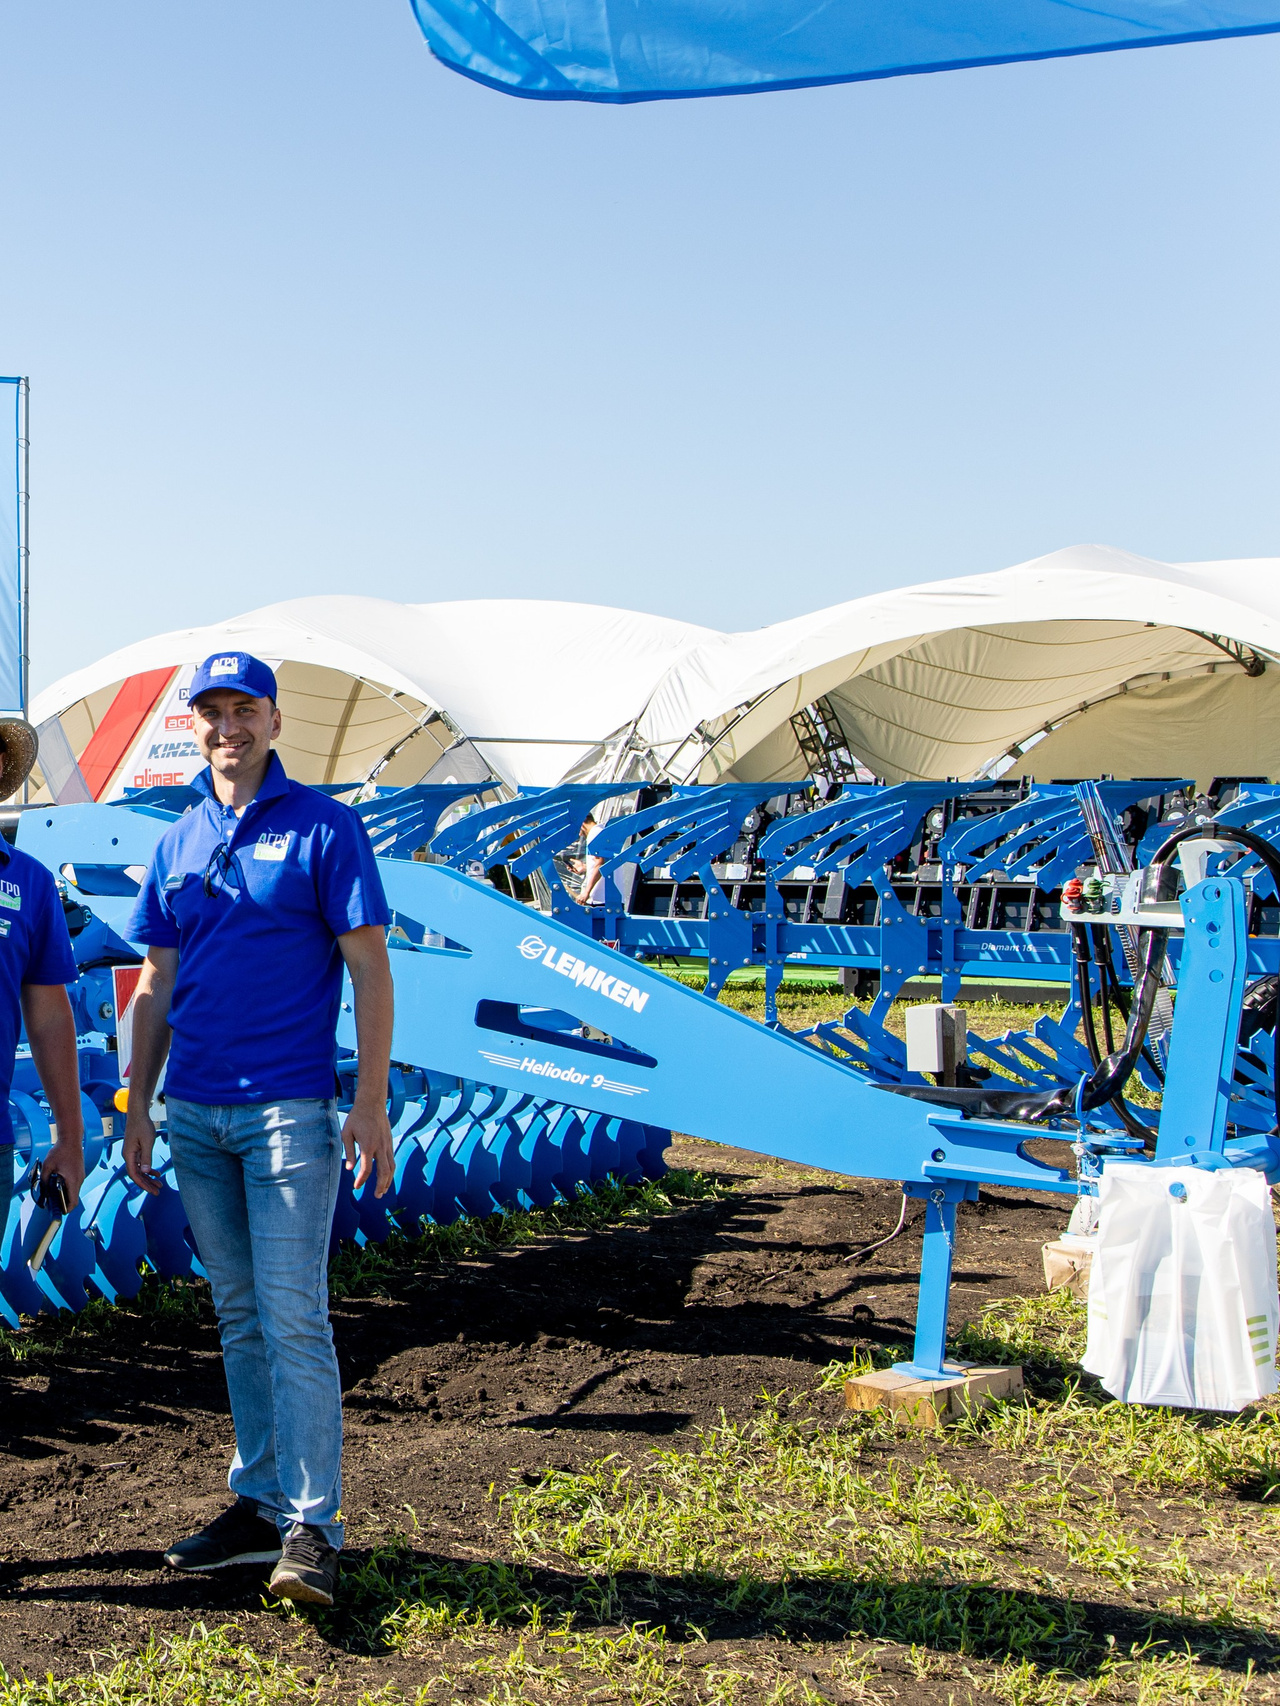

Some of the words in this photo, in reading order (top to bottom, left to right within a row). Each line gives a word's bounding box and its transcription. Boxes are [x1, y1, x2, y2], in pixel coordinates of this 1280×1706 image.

[212, 657, 238, 667] АГРО
[134, 768, 184, 788] olimac
[258, 832, 291, 847] АГРО
[981, 942, 1020, 952] Diamant
[541, 945, 650, 1014] LEMKEN
[519, 1057, 590, 1086] Heliodor
[592, 1073, 605, 1089] 9
